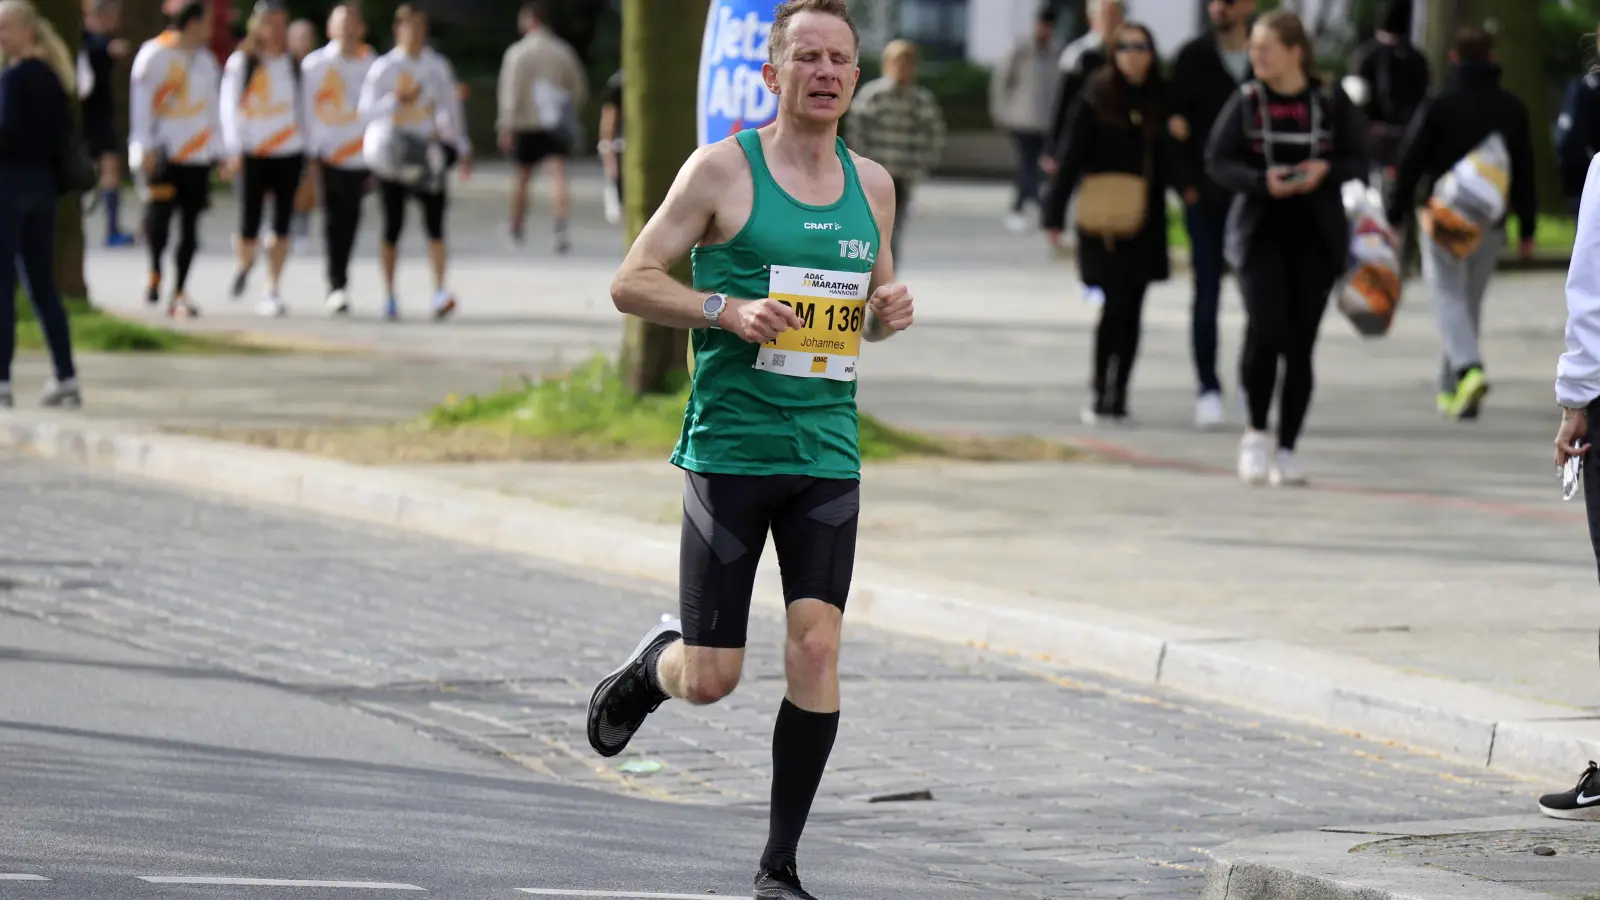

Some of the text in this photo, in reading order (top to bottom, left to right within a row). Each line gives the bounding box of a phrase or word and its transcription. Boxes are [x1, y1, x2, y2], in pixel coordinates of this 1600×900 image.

[708, 64, 778, 121] AfD
[804, 222, 833, 230] CRAFT
[838, 239, 870, 260] TSV
[812, 281, 859, 291] MARATHON
[801, 336, 845, 350] Johannes
